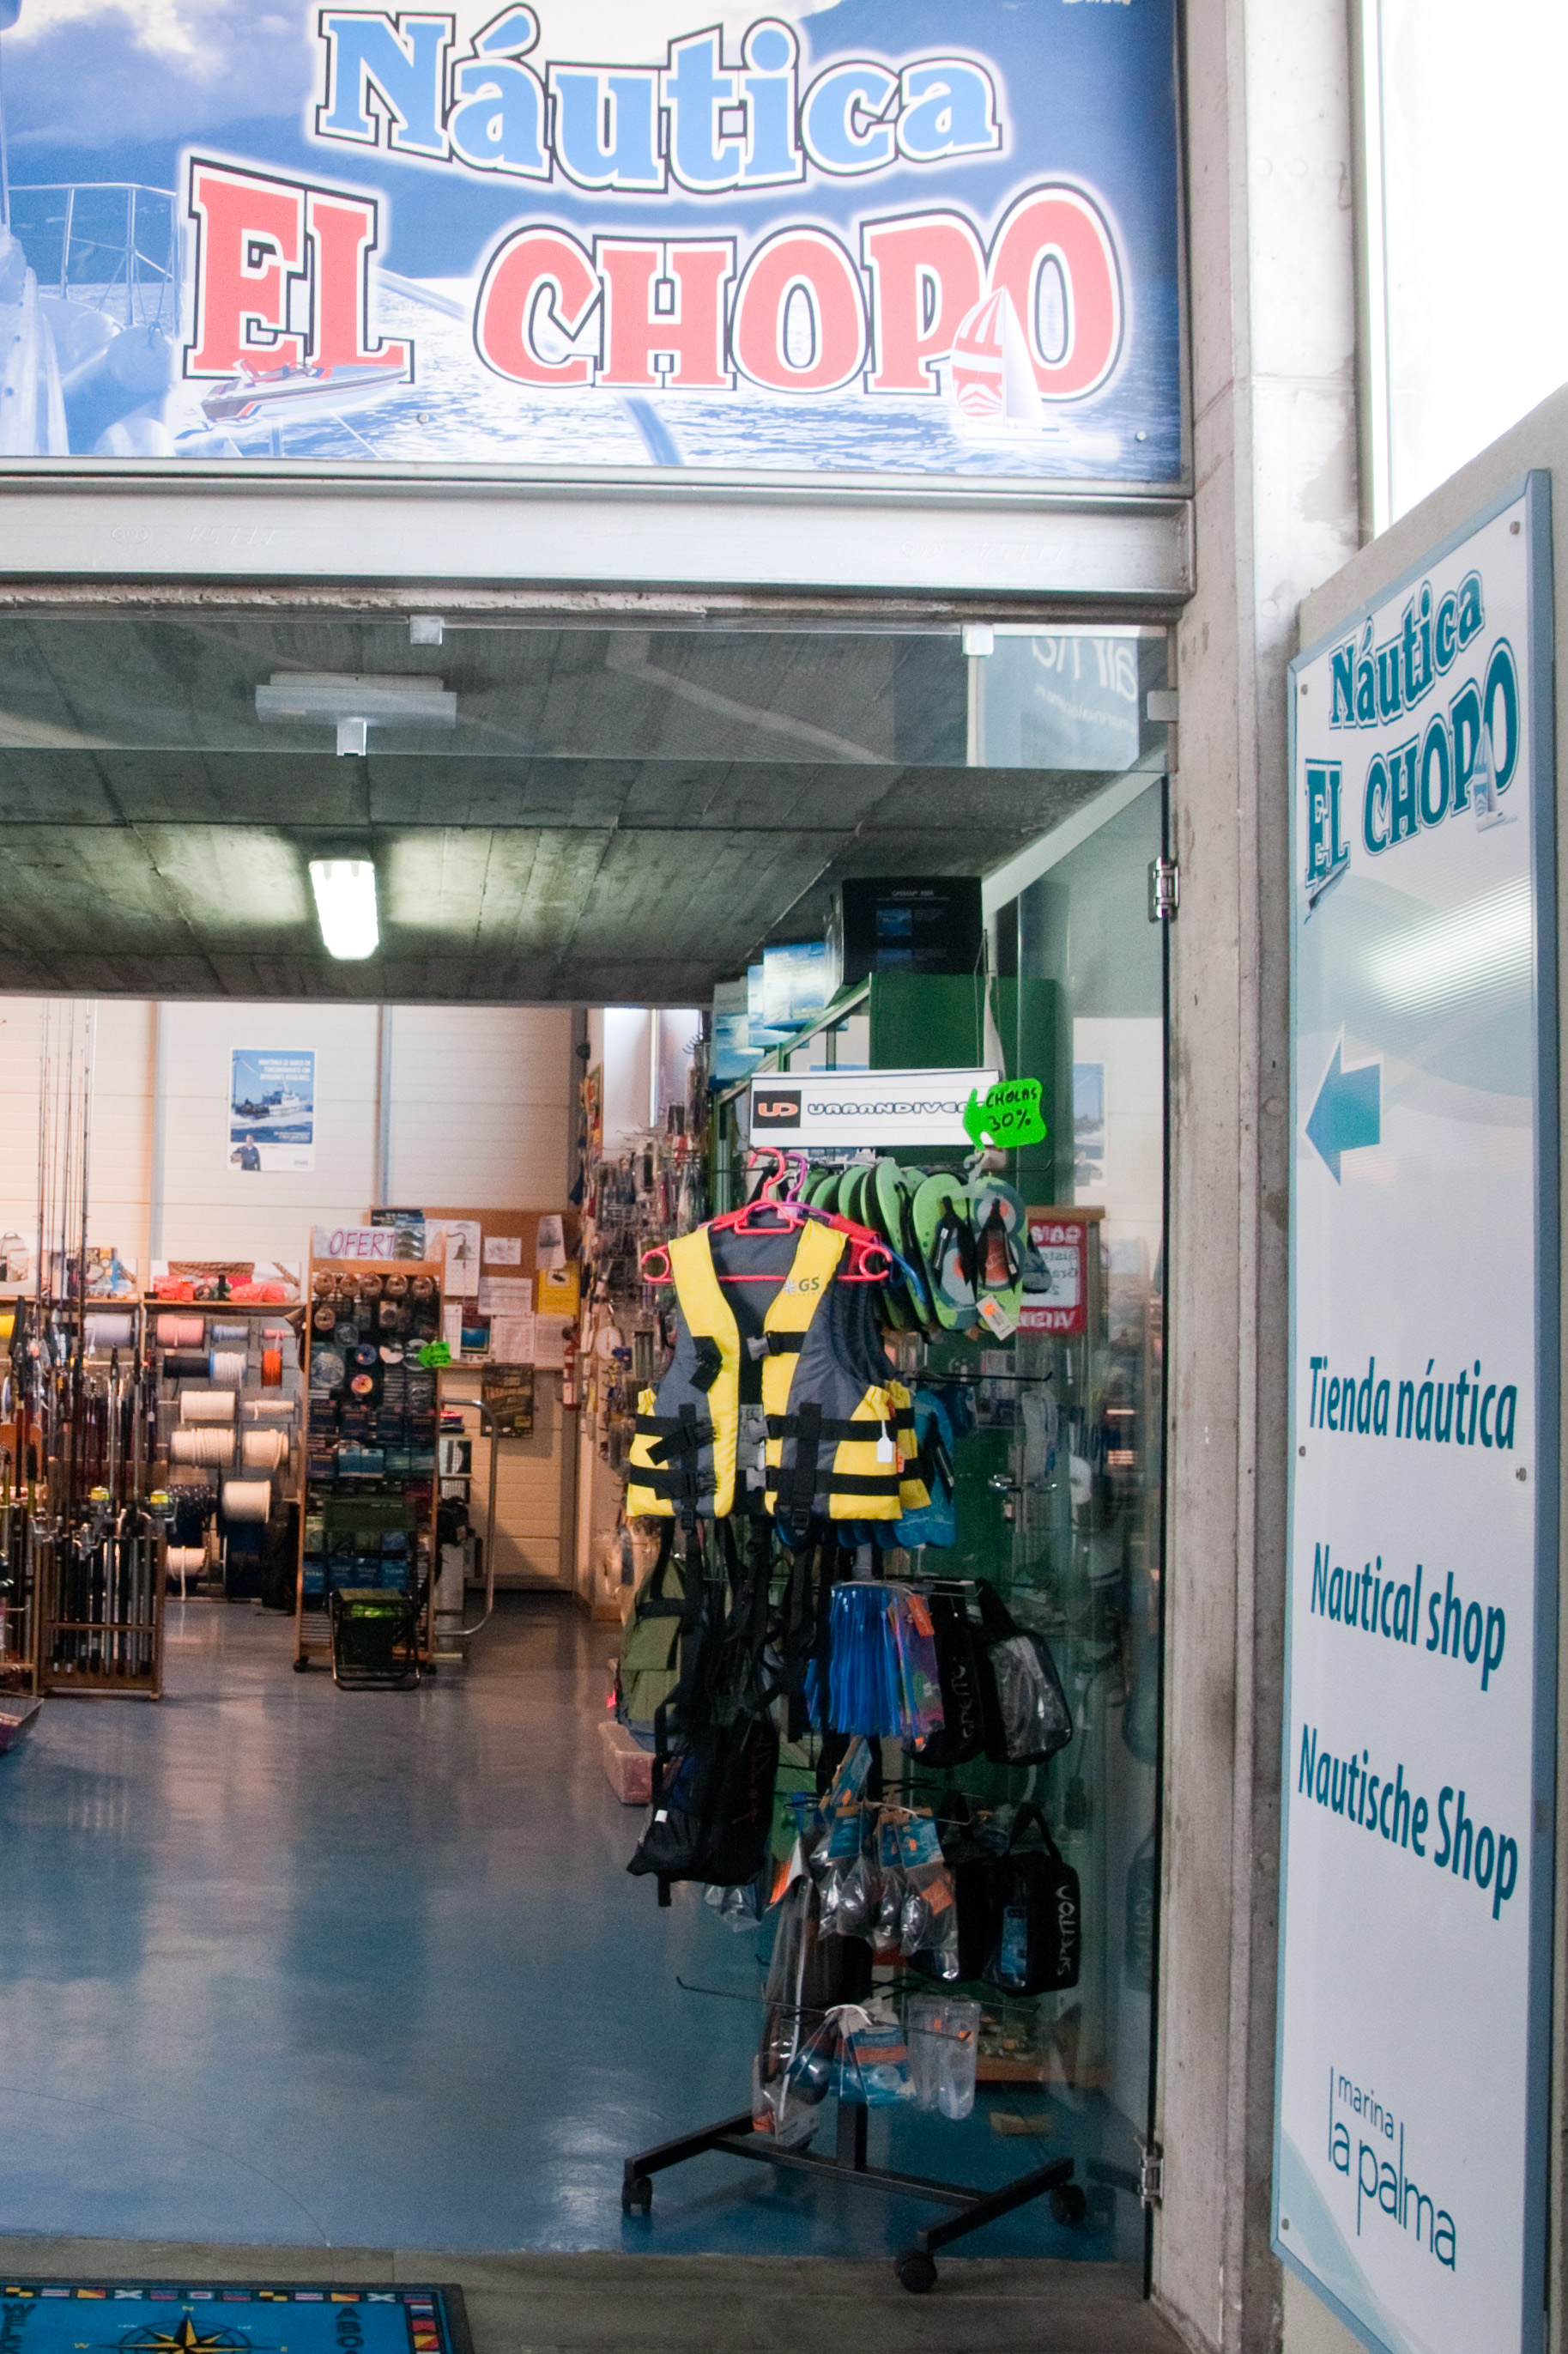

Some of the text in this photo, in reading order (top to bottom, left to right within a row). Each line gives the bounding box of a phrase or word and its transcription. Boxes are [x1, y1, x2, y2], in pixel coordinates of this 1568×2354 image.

[315, 3, 1002, 194] Náutica
[183, 157, 1124, 401] EL CHOPO
[1329, 570, 1485, 730] Náutica
[1305, 637, 1521, 888] EL CHOPO
[758, 1101, 985, 1117] UD URBANDIVE
[985, 1085, 1037, 1108] CHOLAS
[986, 1109, 1031, 1132] 30%
[798, 1276, 820, 1292] GS
[1310, 1356, 1517, 1449] Tienda náutica
[1310, 1542, 1505, 1691] Nautical shop
[1298, 1723, 1518, 1920] Nautische Shop
[1328, 2066, 1456, 2272] la palma
[1338, 2072, 1395, 2141] marina
